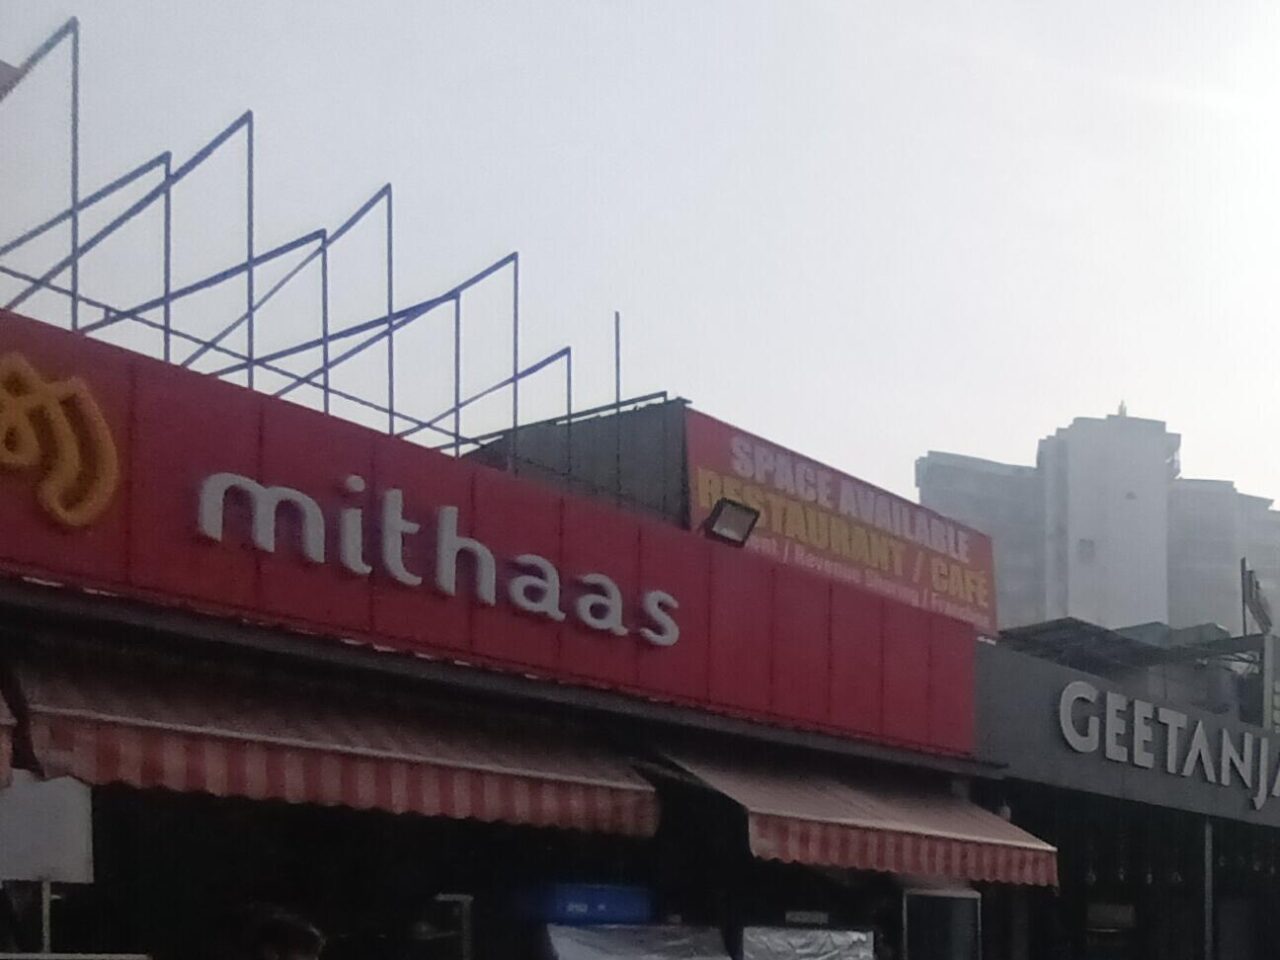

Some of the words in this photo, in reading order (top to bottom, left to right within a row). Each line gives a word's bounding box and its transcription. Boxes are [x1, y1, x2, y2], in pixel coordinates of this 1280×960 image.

[198, 472, 680, 648] mithaas
[731, 435, 832, 508] SPACE
[839, 476, 969, 563] AVAILABLE
[931, 557, 989, 609] CAFE
